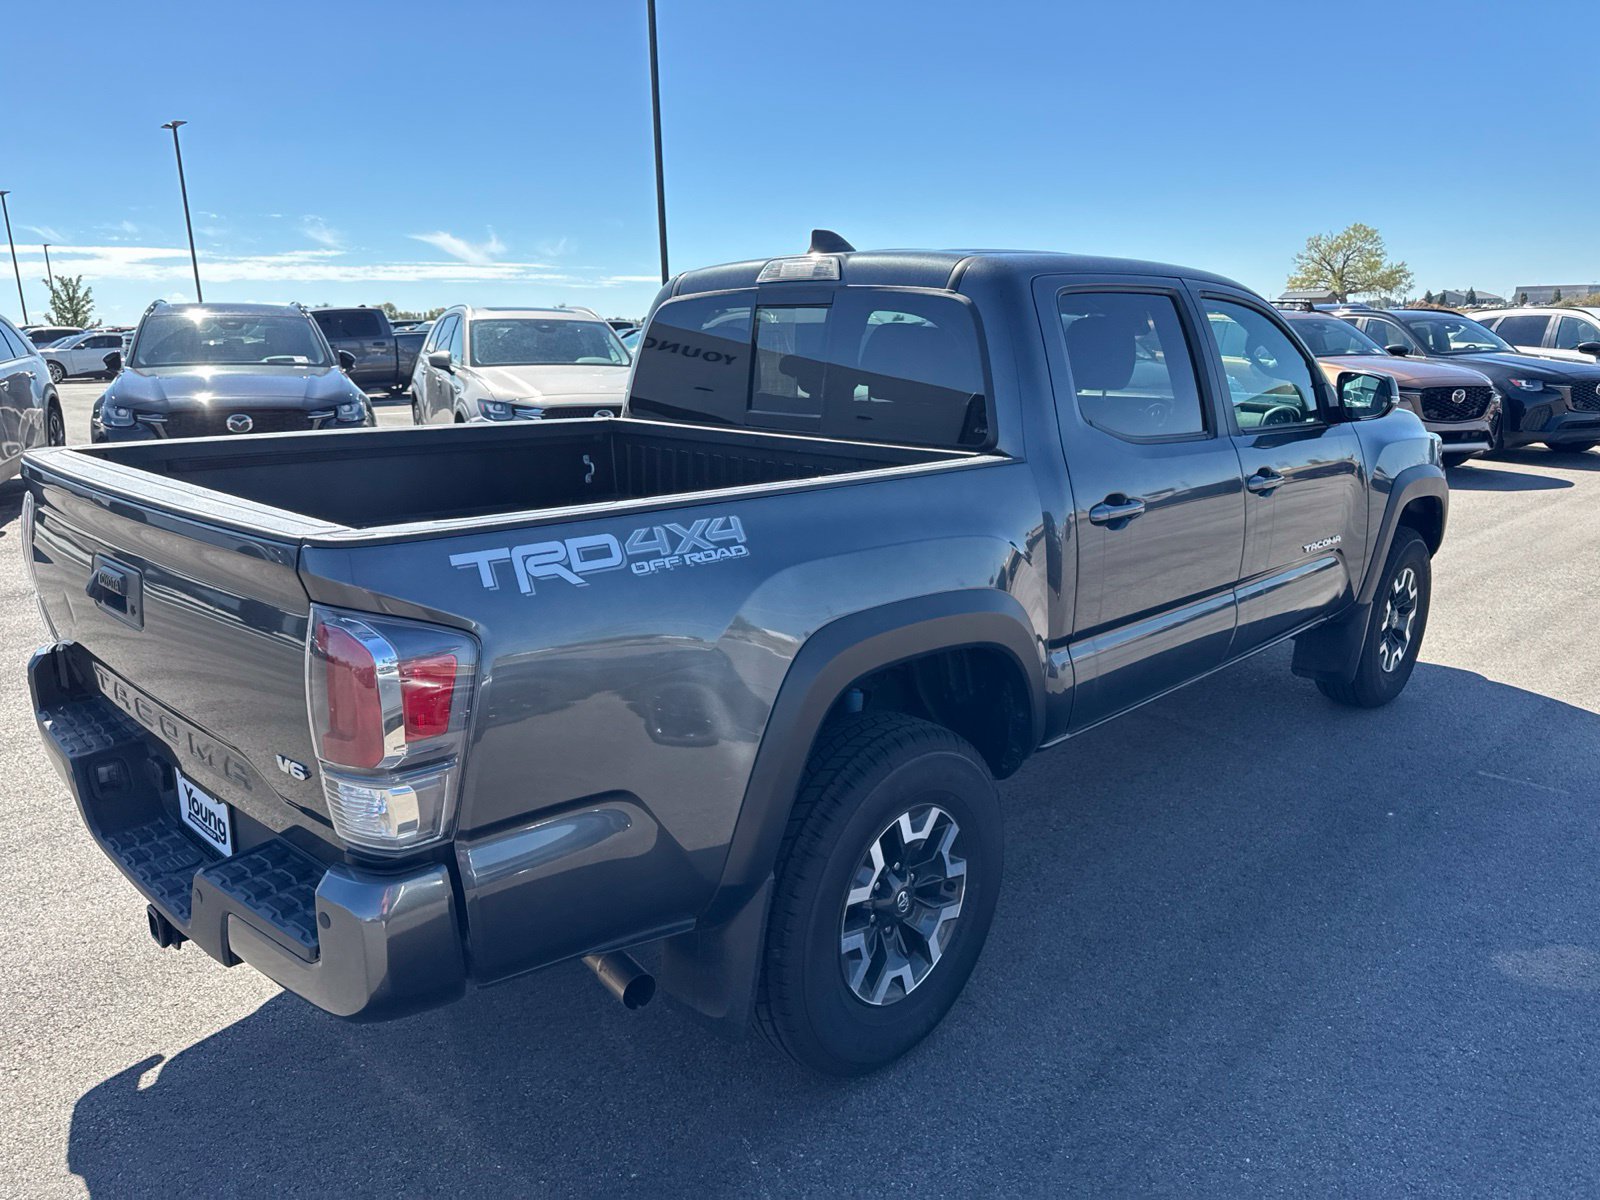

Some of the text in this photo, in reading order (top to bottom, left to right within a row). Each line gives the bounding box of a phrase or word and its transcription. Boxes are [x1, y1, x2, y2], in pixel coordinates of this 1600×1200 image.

[449, 533, 627, 596] TRD
[630, 545, 750, 576] OFF ROAD
[1303, 534, 1342, 552] TACOMA
[93, 661, 253, 792] TACOMA
[275, 753, 312, 781] V6
[183, 783, 227, 846] Young
